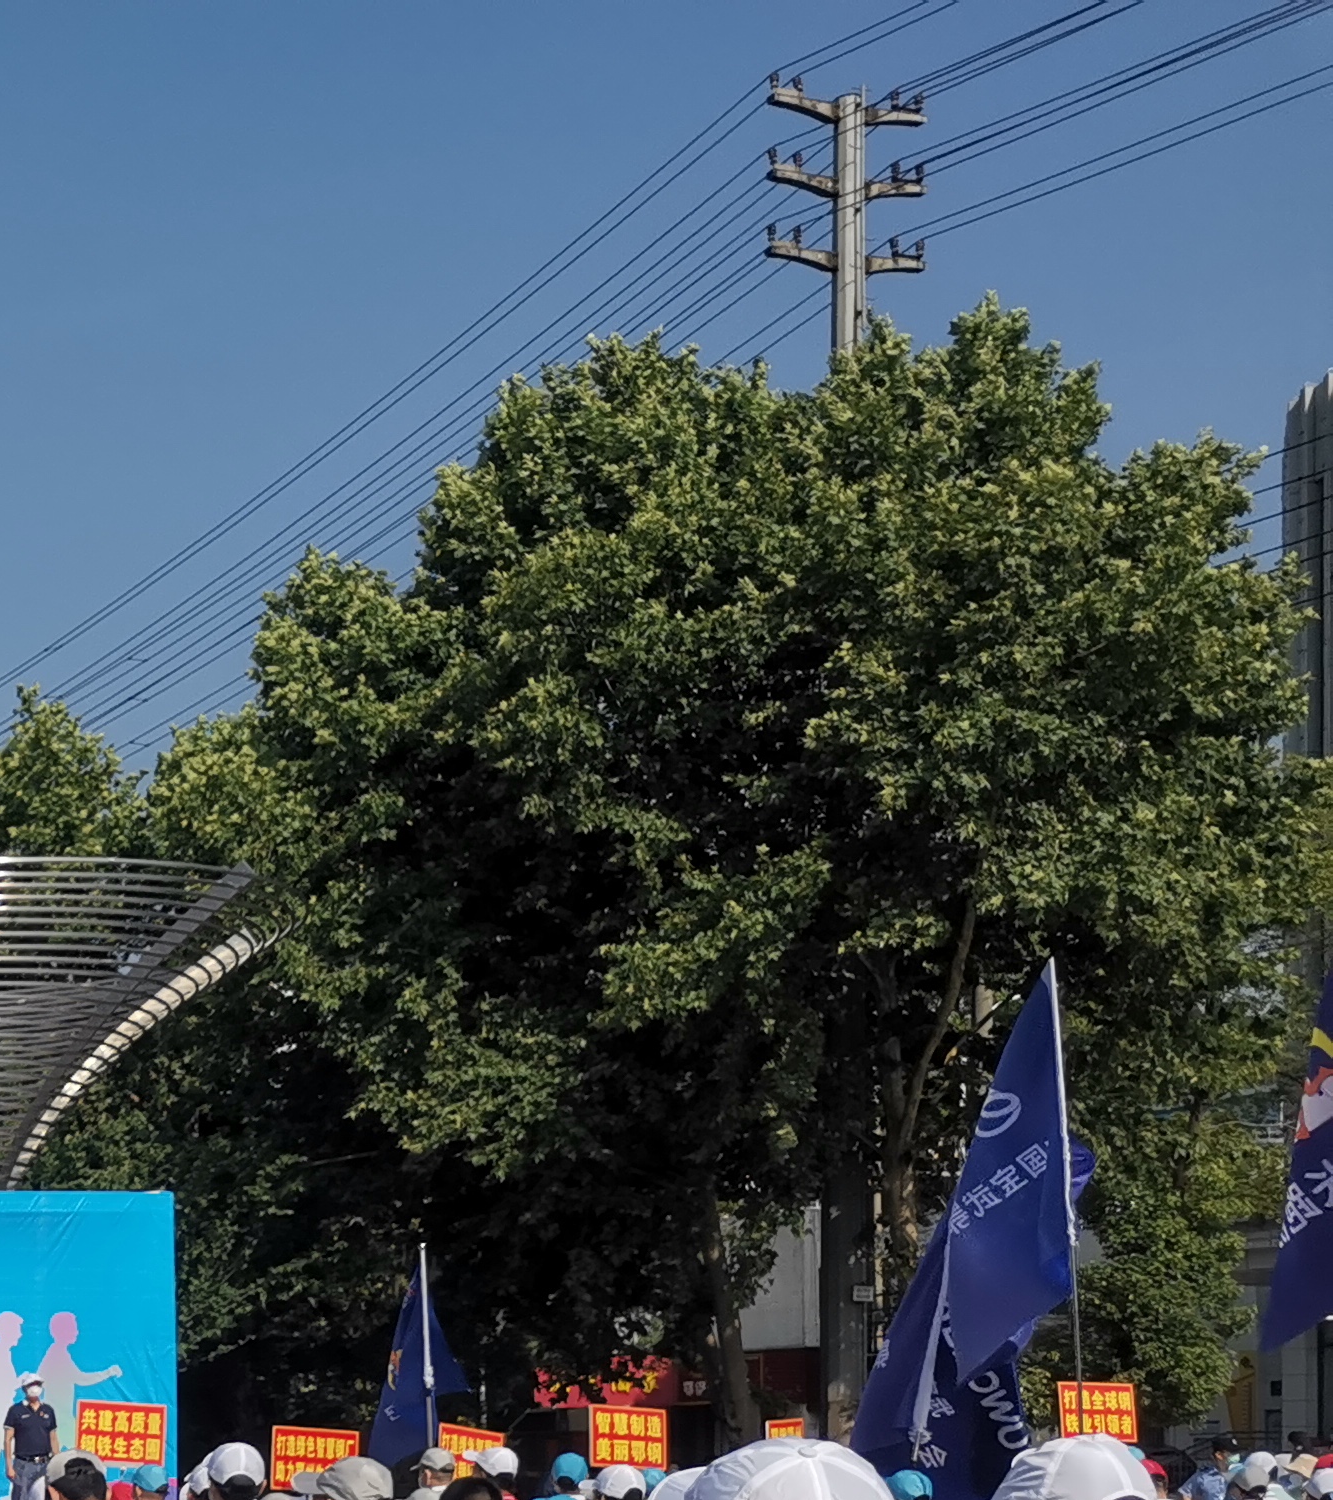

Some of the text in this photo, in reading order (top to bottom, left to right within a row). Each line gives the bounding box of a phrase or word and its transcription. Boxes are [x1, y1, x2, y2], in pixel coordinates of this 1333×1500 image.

[80, 1408, 162, 1436] 共建高质量
[595, 1410, 663, 1438] 智慧制造
[79, 1433, 162, 1461] 钢铁生态圈
[595, 1437, 663, 1465] 美丽鄂钢
